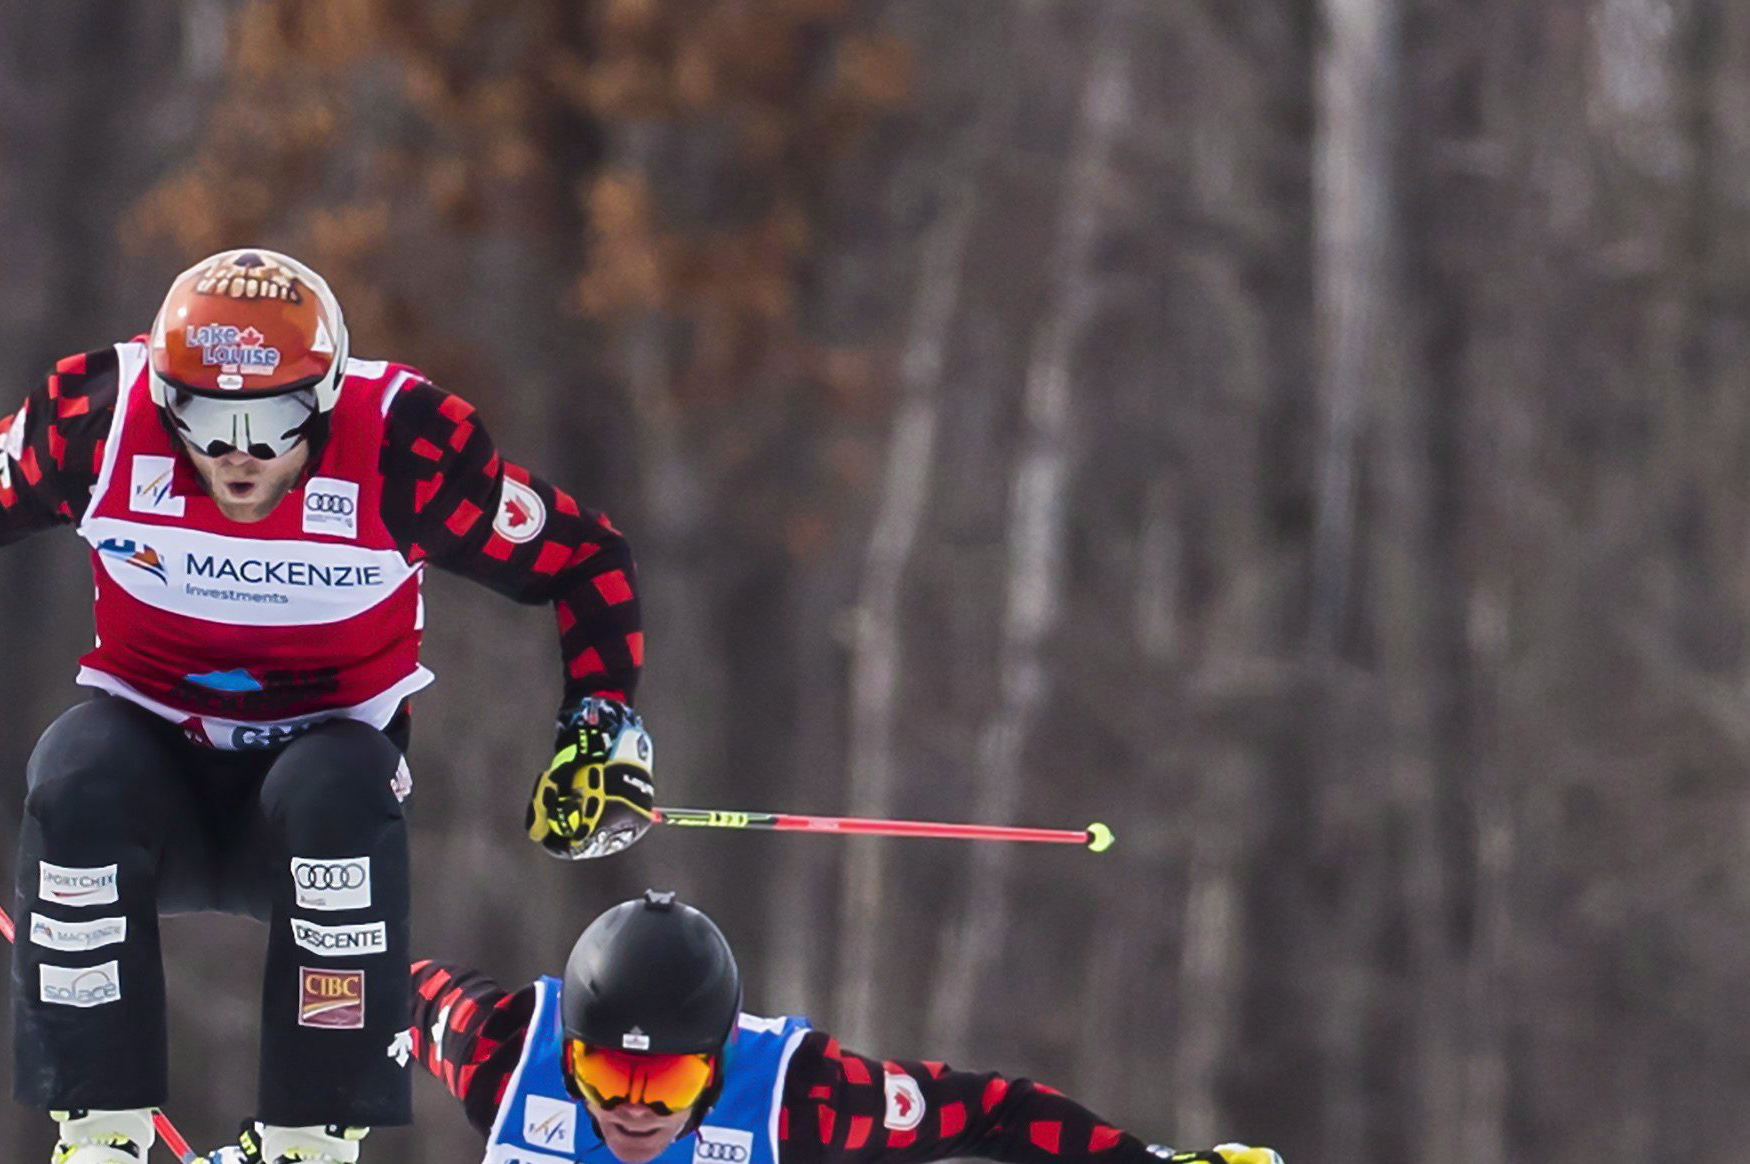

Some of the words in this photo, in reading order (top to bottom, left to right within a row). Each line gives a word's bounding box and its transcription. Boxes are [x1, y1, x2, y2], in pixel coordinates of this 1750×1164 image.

[186, 553, 383, 587] MACKENZIE
[185, 583, 289, 604] Investments
[296, 925, 383, 949] DESCENTE
[305, 974, 360, 997] CIBC
